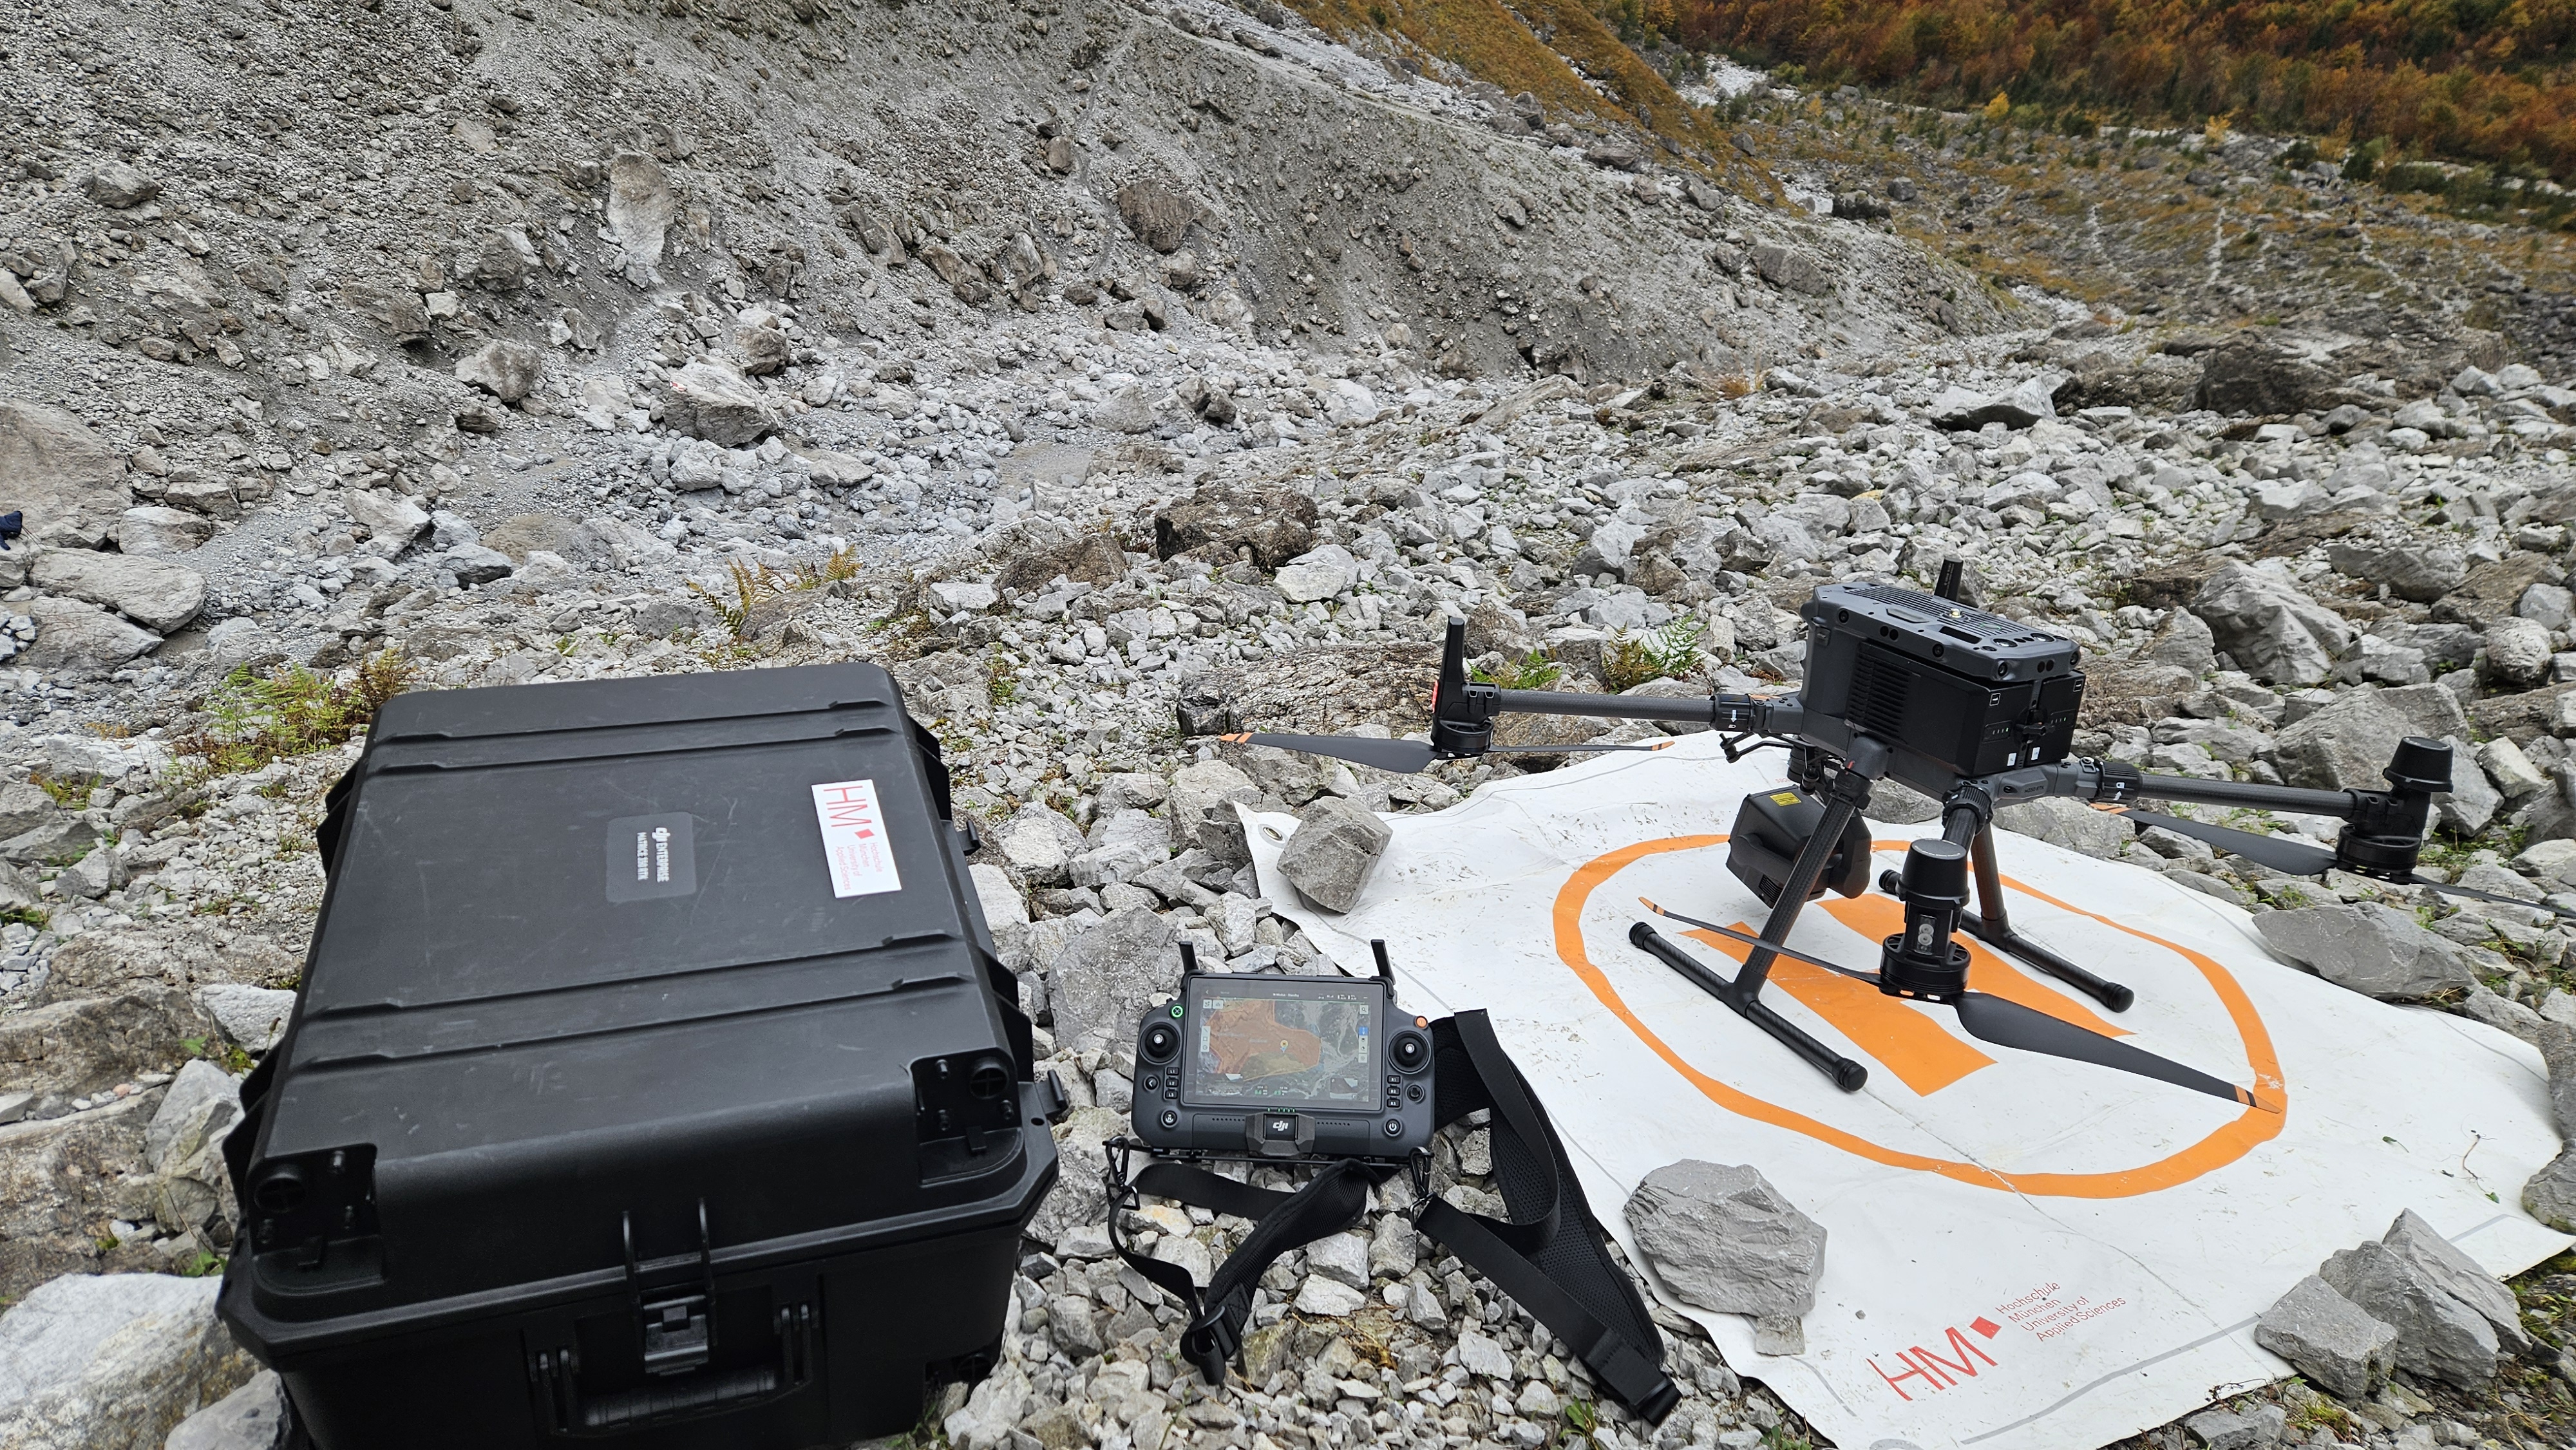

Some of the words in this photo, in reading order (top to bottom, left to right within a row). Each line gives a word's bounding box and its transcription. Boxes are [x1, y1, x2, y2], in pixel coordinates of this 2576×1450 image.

[824, 786, 872, 827] HM
[637, 832, 648, 857] MATRICE
[836, 846, 847, 866] Applied
[848, 845, 860, 871] University
[858, 843, 869, 867] München
[870, 842, 884, 872] Hochschule
[638, 867, 649, 881] RTK
[656, 842, 669, 883] ENTERPRISE
[840, 865, 851, 890] Sciences
[1995, 1282, 2060, 1314] Hochschule
[2008, 1298, 2061, 1323] München
[2021, 1303, 2079, 1332] University
[2076, 1296, 2090, 1306] of
[2036, 1315, 2080, 1342] Applied
[2076, 1297, 2126, 1321] Sciences
[1865, 1326, 1998, 1402] HM
